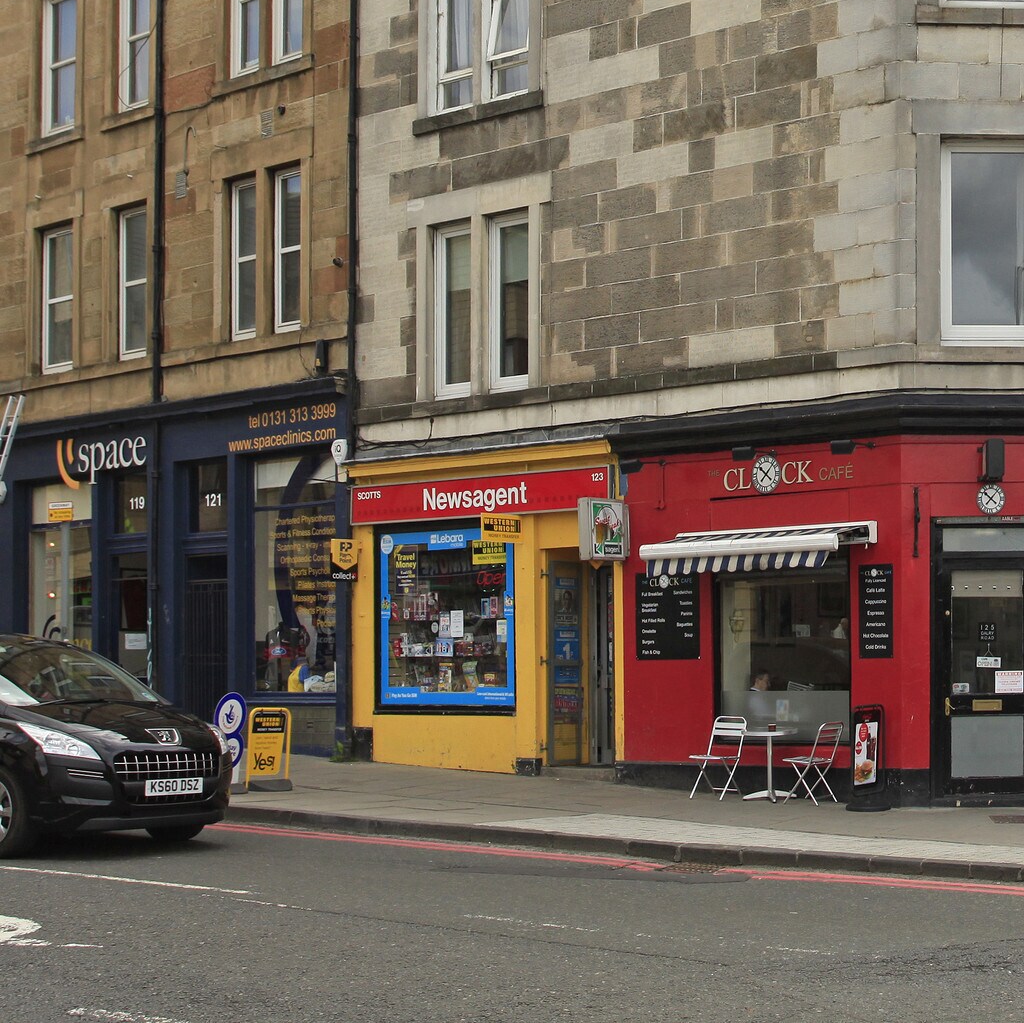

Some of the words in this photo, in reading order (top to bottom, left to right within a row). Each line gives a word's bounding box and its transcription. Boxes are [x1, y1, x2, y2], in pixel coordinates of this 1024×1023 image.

[248, 413, 260, 429] tel
[262, 410, 286, 427] 0131
[289, 406, 308, 424] 313
[311, 402, 336, 420] 3999
[228, 427, 336, 452] www.spaceclinics.com
[78, 436, 147, 485] space
[591, 472, 604, 482] 123
[818, 462, 854, 481] CAFÉ
[205, 493, 222, 507] 121
[357, 490, 381, 501] SCOTTS
[422, 481, 528, 512] Newsagent
[129, 496, 145, 510] 119
[484, 518, 515, 526] WESTERN
[436, 534, 464, 544] Lebara
[396, 553, 415, 561] Travel
[395, 561, 417, 569] Money
[253, 752, 276, 770] Yes!
[150, 780, 178, 793] KS60
[181, 779, 199, 791] DSZ
